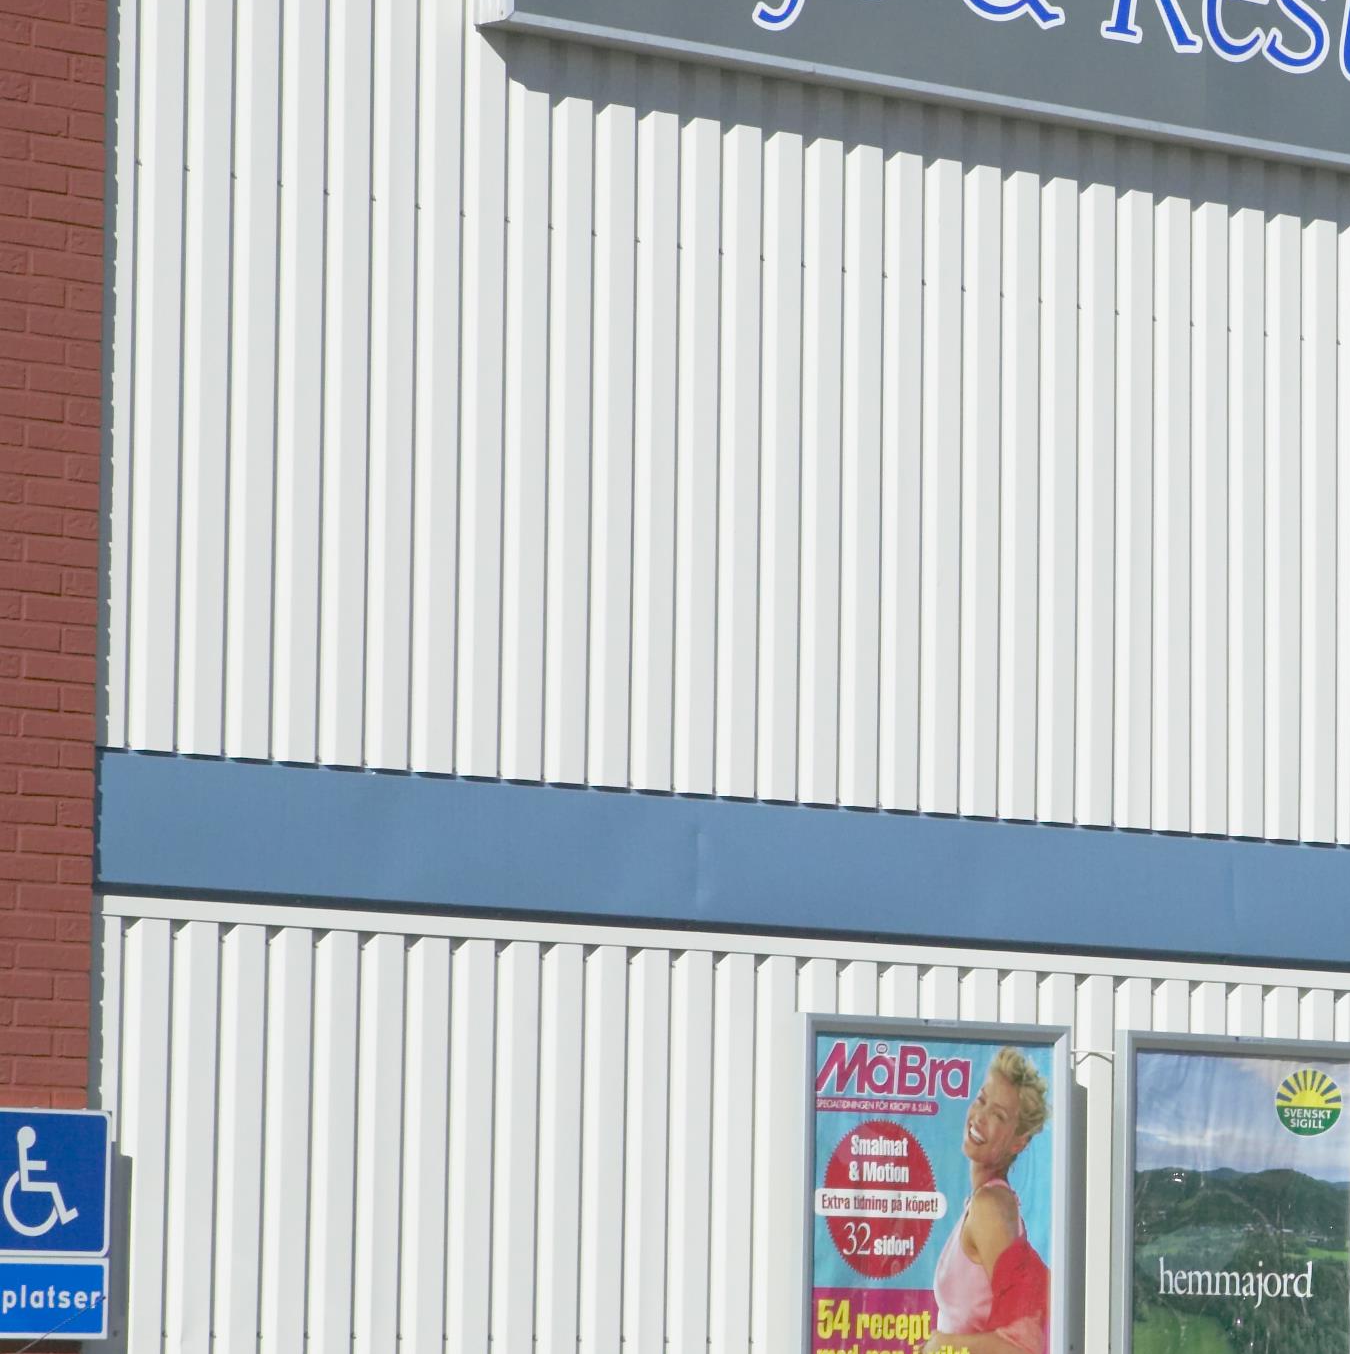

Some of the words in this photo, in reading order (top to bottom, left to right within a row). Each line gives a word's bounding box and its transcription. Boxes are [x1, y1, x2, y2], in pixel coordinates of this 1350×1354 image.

[815, 1040, 973, 1101] MåBra
[1283, 1108, 1332, 1120] SVENSKT
[1289, 1118, 1325, 1130] SIGILL
[850, 1134, 909, 1157] Smalmat
[848, 1160, 860, 1182] &
[862, 1161, 910, 1183] Motion
[821, 1194, 851, 1210] Extra
[853, 1195, 888, 1213] tidning
[890, 1193, 903, 1214] på
[905, 1196, 939, 1214] köpet!
[842, 1221, 872, 1256] 32
[873, 1235, 915, 1256] sidor!
[1158, 1256, 1314, 1309] hemmajord
[2, 1284, 101, 1315] platser
[816, 1299, 851, 1340] 54
[855, 1310, 932, 1346] recept
